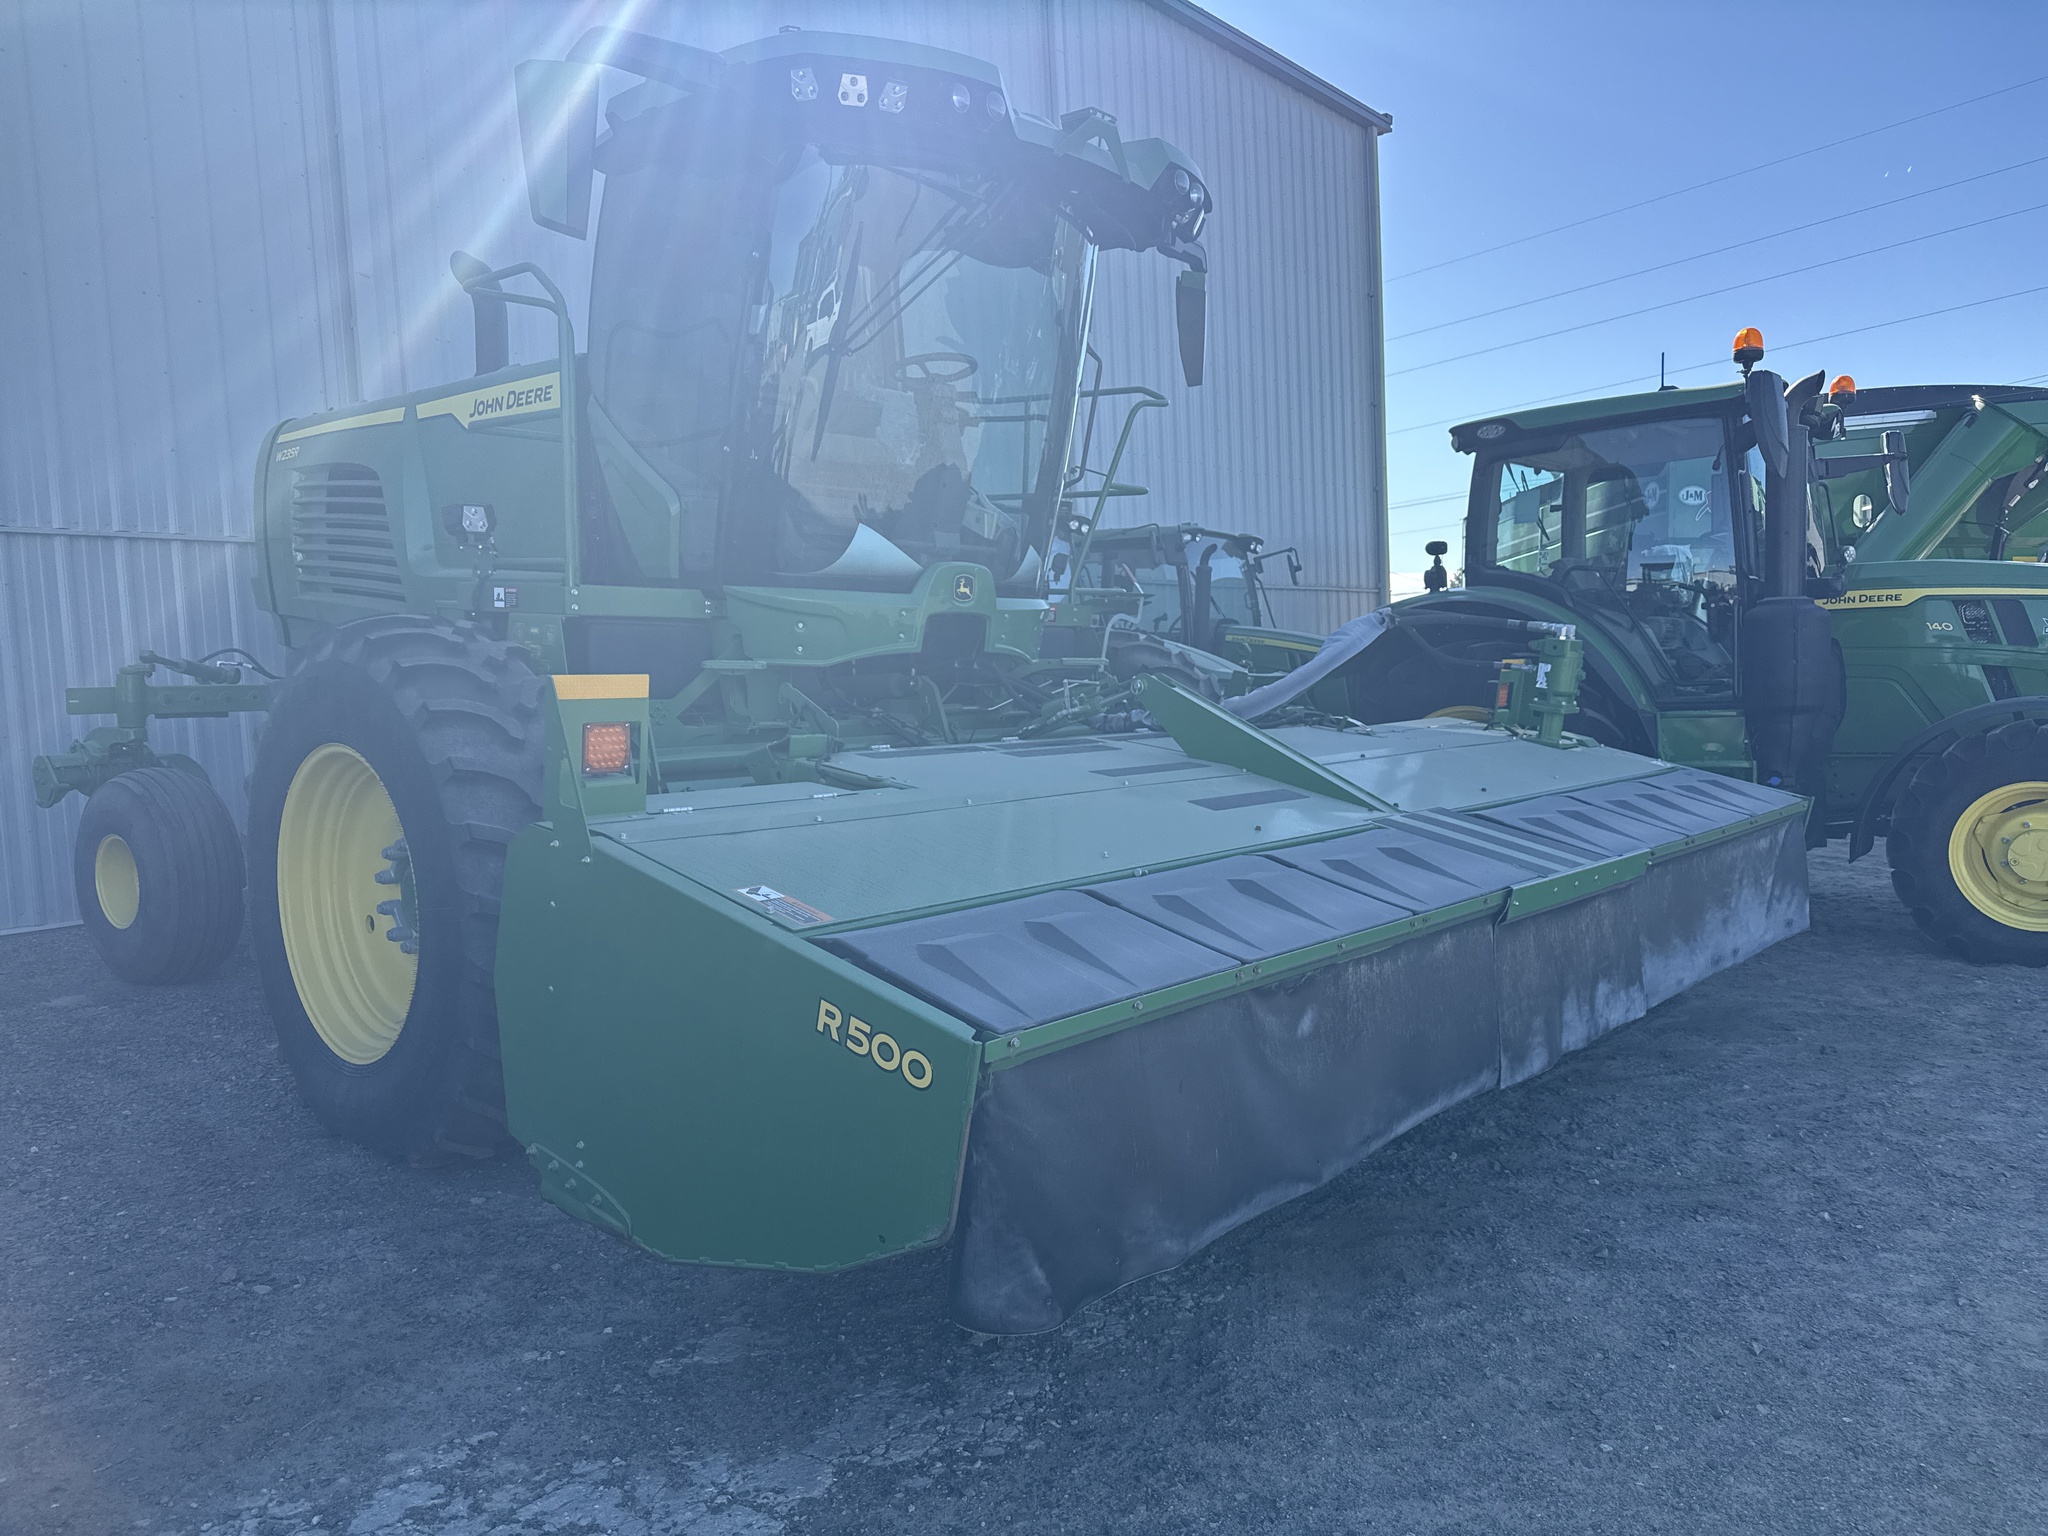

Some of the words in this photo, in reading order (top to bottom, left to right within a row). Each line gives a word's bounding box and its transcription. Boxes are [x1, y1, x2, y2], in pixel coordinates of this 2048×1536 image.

[469, 396, 504, 418] JOHN
[506, 385, 553, 410] DEERE
[276, 446, 300, 462] W235R
[1682, 490, 1703, 501] J&M
[1822, 596, 1856, 605] JOHN
[1859, 594, 1903, 603] DEERE
[1926, 622, 1953, 631] 140
[816, 998, 933, 1089] R500
